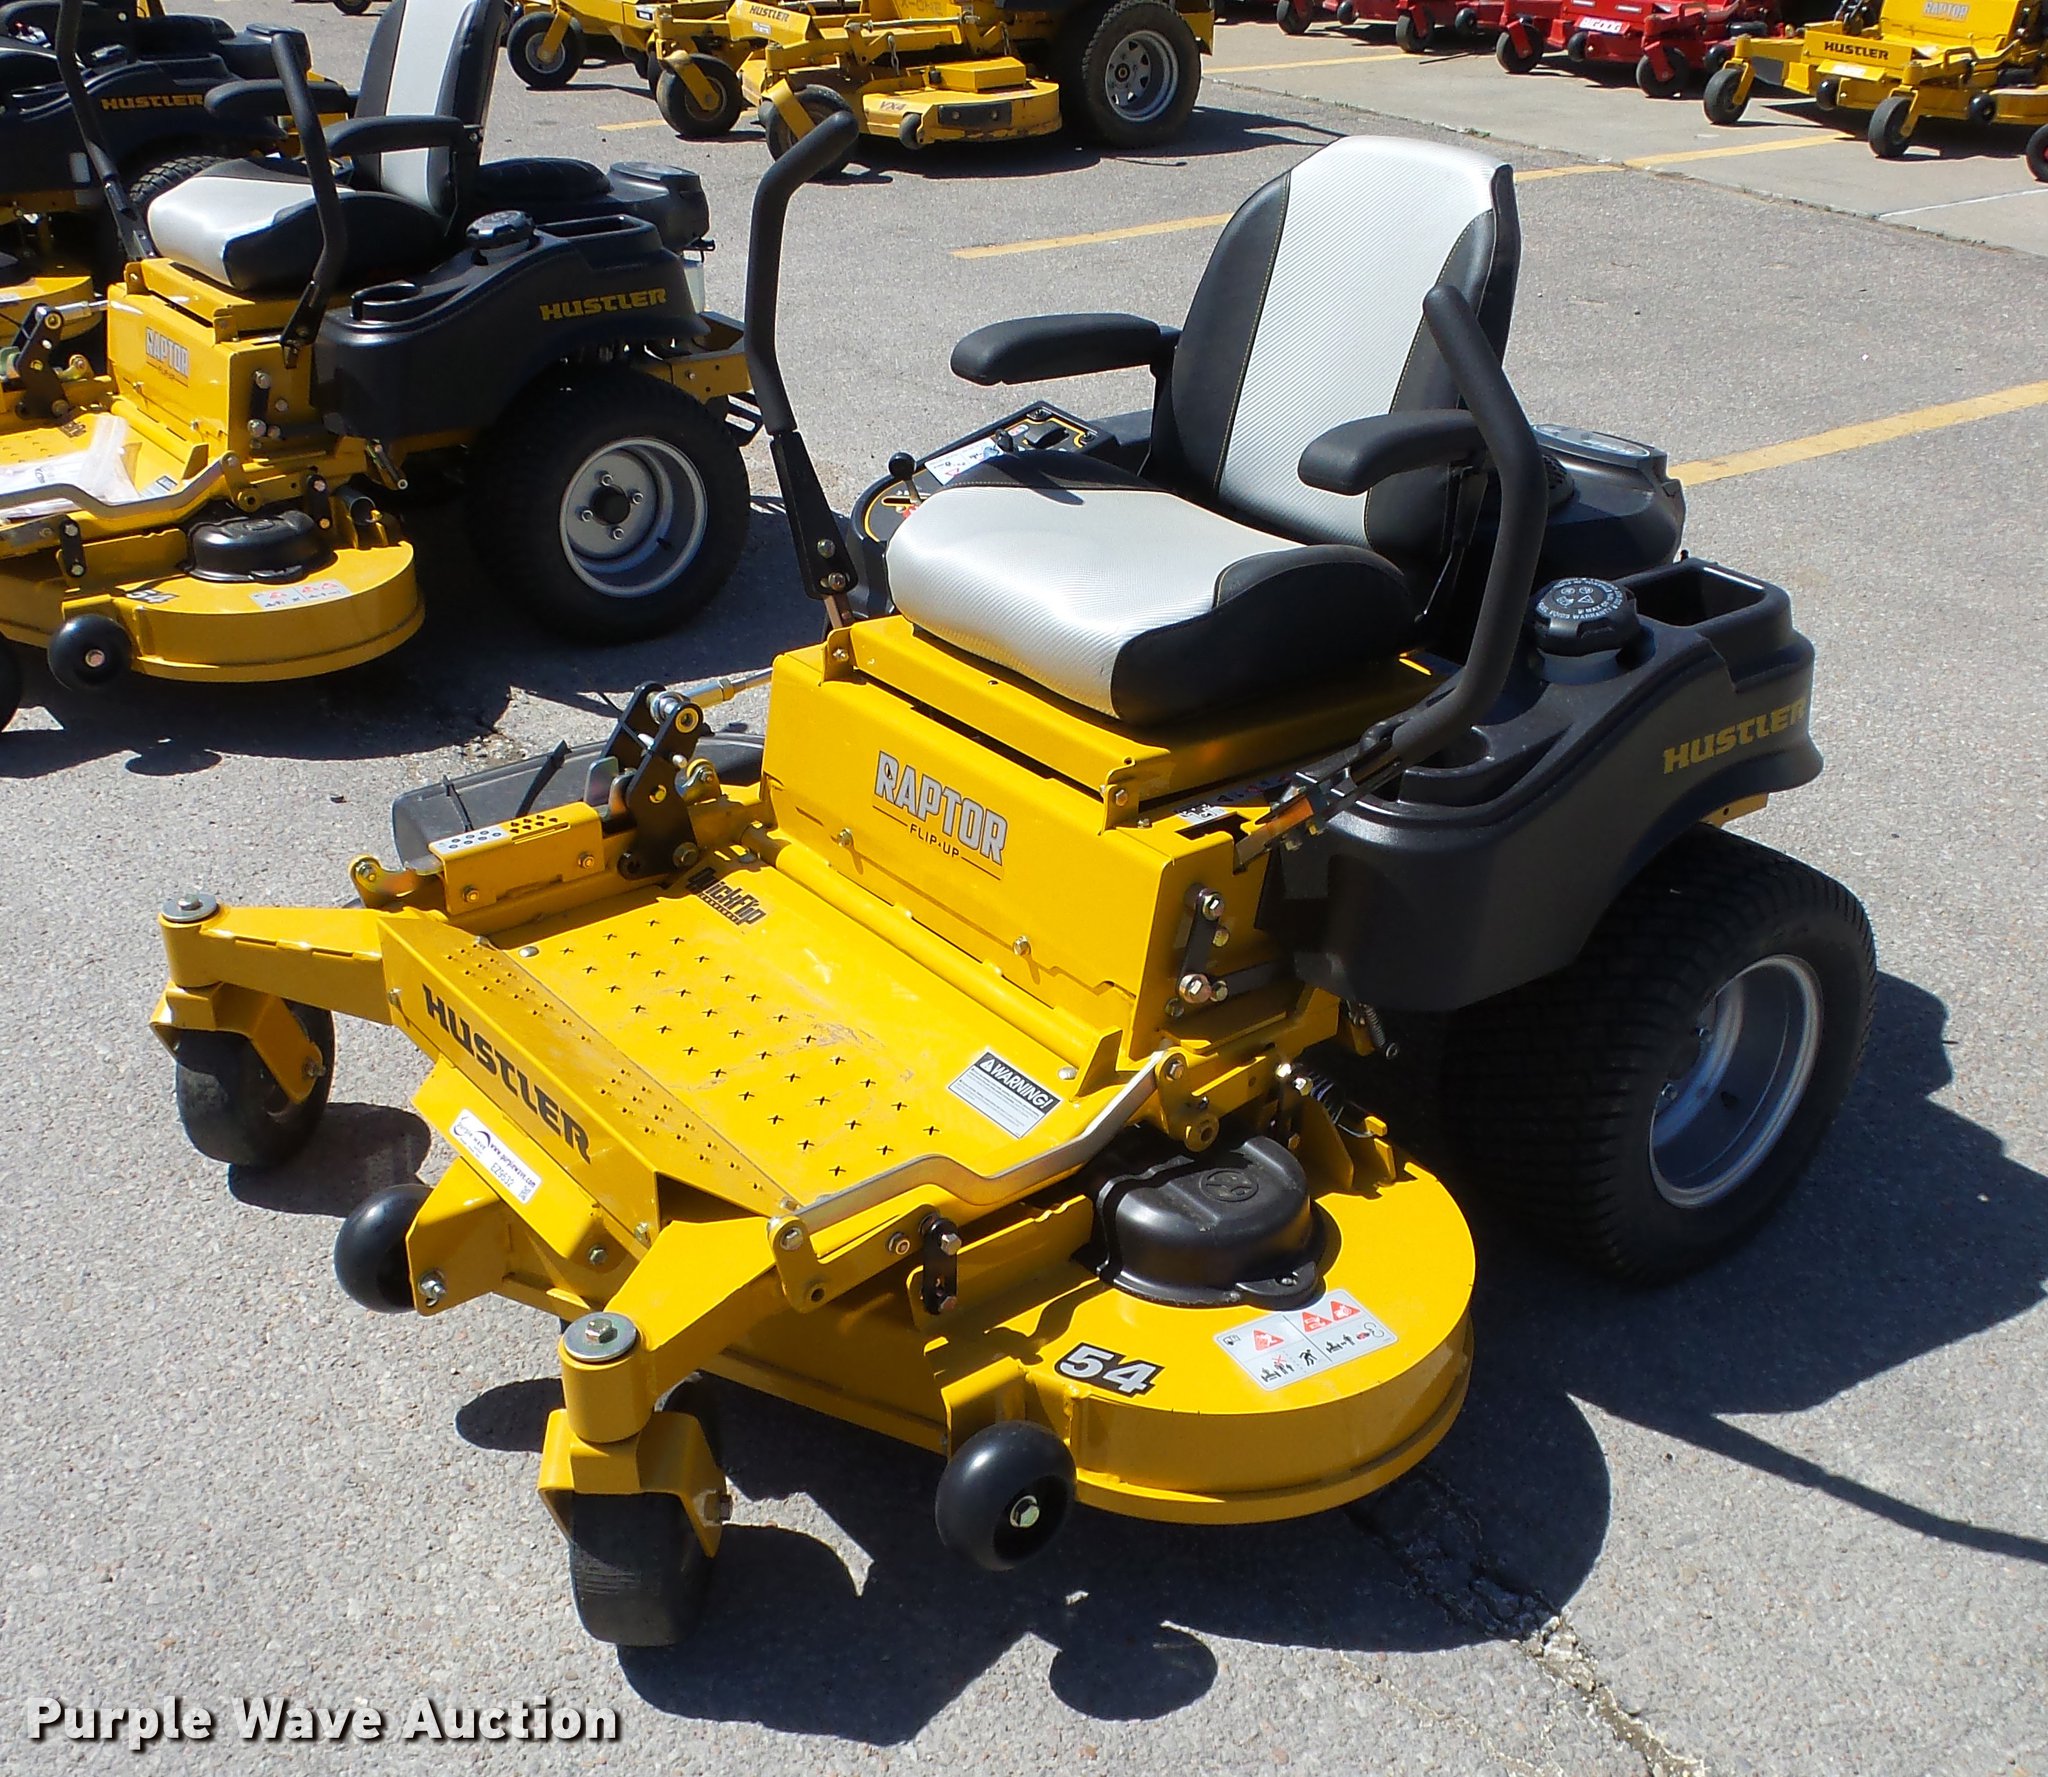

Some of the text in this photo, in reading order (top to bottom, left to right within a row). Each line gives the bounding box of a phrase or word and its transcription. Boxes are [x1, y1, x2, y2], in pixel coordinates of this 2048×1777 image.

[749, 4, 790, 23] HUSTLER
[1923, 0, 1969, 21] RAPTOR
[1823, 40, 1890, 61] HUSTLER
[100, 93, 206, 111] HUSTLER
[880, 101, 907, 111] VX4
[538, 287, 667, 321] HUSTLER
[1662, 697, 1807, 775] HUSTLER
[874, 749, 1009, 867] RAPTOR
[422, 983, 592, 1166] HUSTLER
[990, 1062, 1054, 1110] WARNING!
[1057, 1343, 1162, 1396] 54
